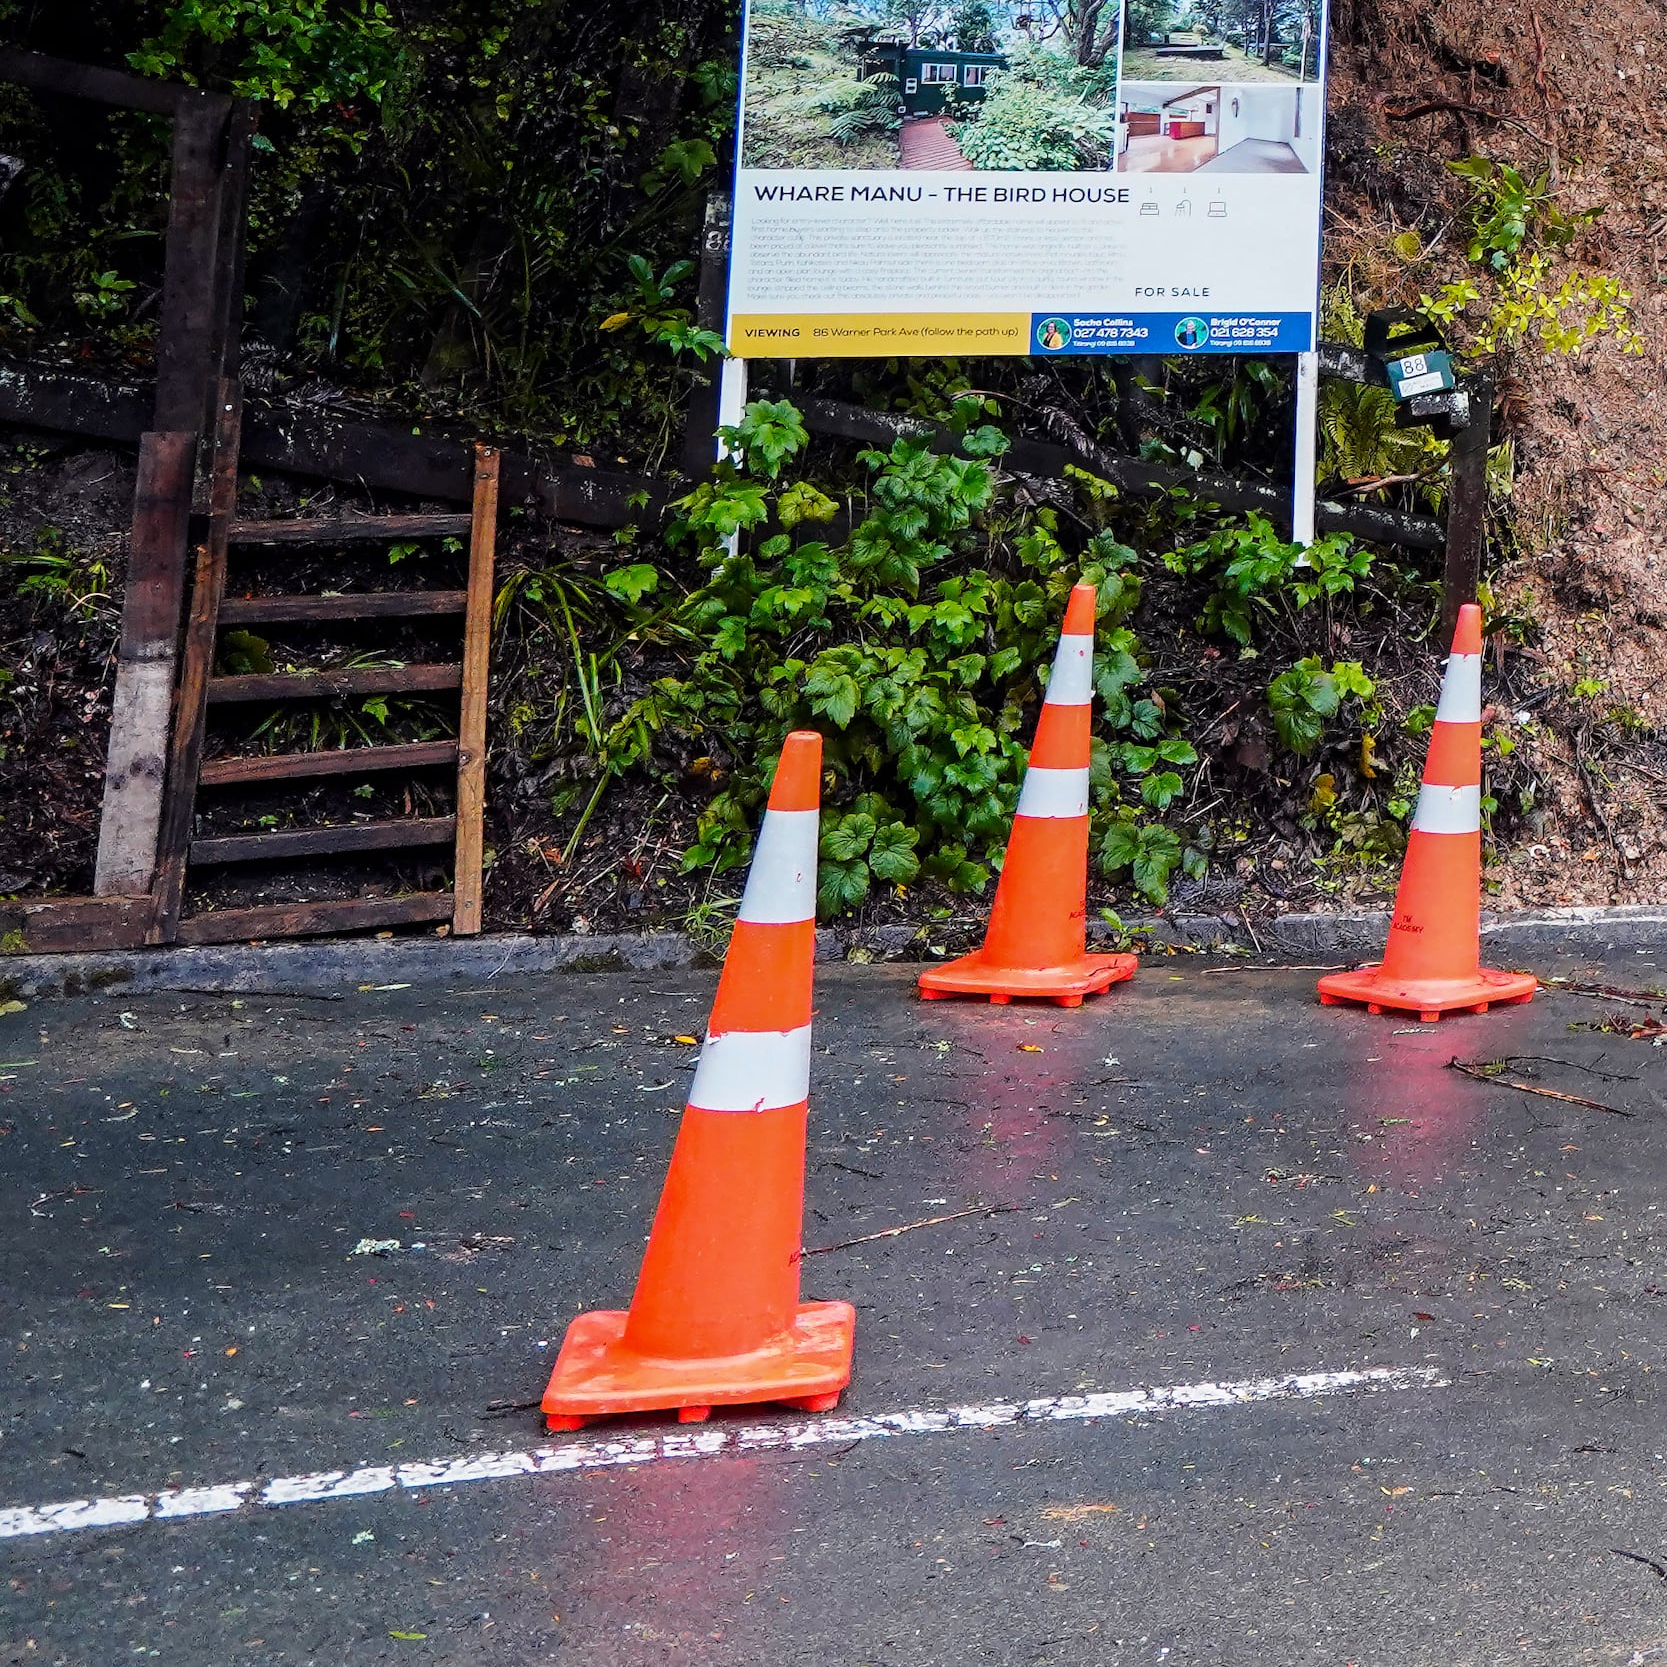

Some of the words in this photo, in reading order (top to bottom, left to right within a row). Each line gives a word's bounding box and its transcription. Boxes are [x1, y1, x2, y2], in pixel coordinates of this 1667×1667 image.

[754, 186, 844, 201] WHARE
[851, 186, 922, 202] MANU
[944, 187, 987, 202] THE
[994, 188, 1046, 203] BIRD
[1053, 188, 1130, 203] HOUSE
[1135, 287, 1165, 297] FOR
[1171, 287, 1210, 297] SALE
[745, 328, 800, 338] VIEWING
[813, 328, 829, 337] 86
[831, 328, 870, 337] Warner
[873, 327, 897, 337] Park
[898, 327, 919, 337] Ave
[920, 327, 955, 338] (follow
[956, 327, 974, 336] the
[975, 327, 1000, 338] path
[1001, 327, 1019, 338] up)
[1073, 328, 1096, 338] 027
[1096, 328, 1118, 338] 478
[1120, 327, 1148, 338] 7343
[1210, 327, 1230, 338] 021
[1232, 327, 1255, 338] 628
[1256, 327, 1278, 337] 354
[1404, 358, 1424, 374] 88
